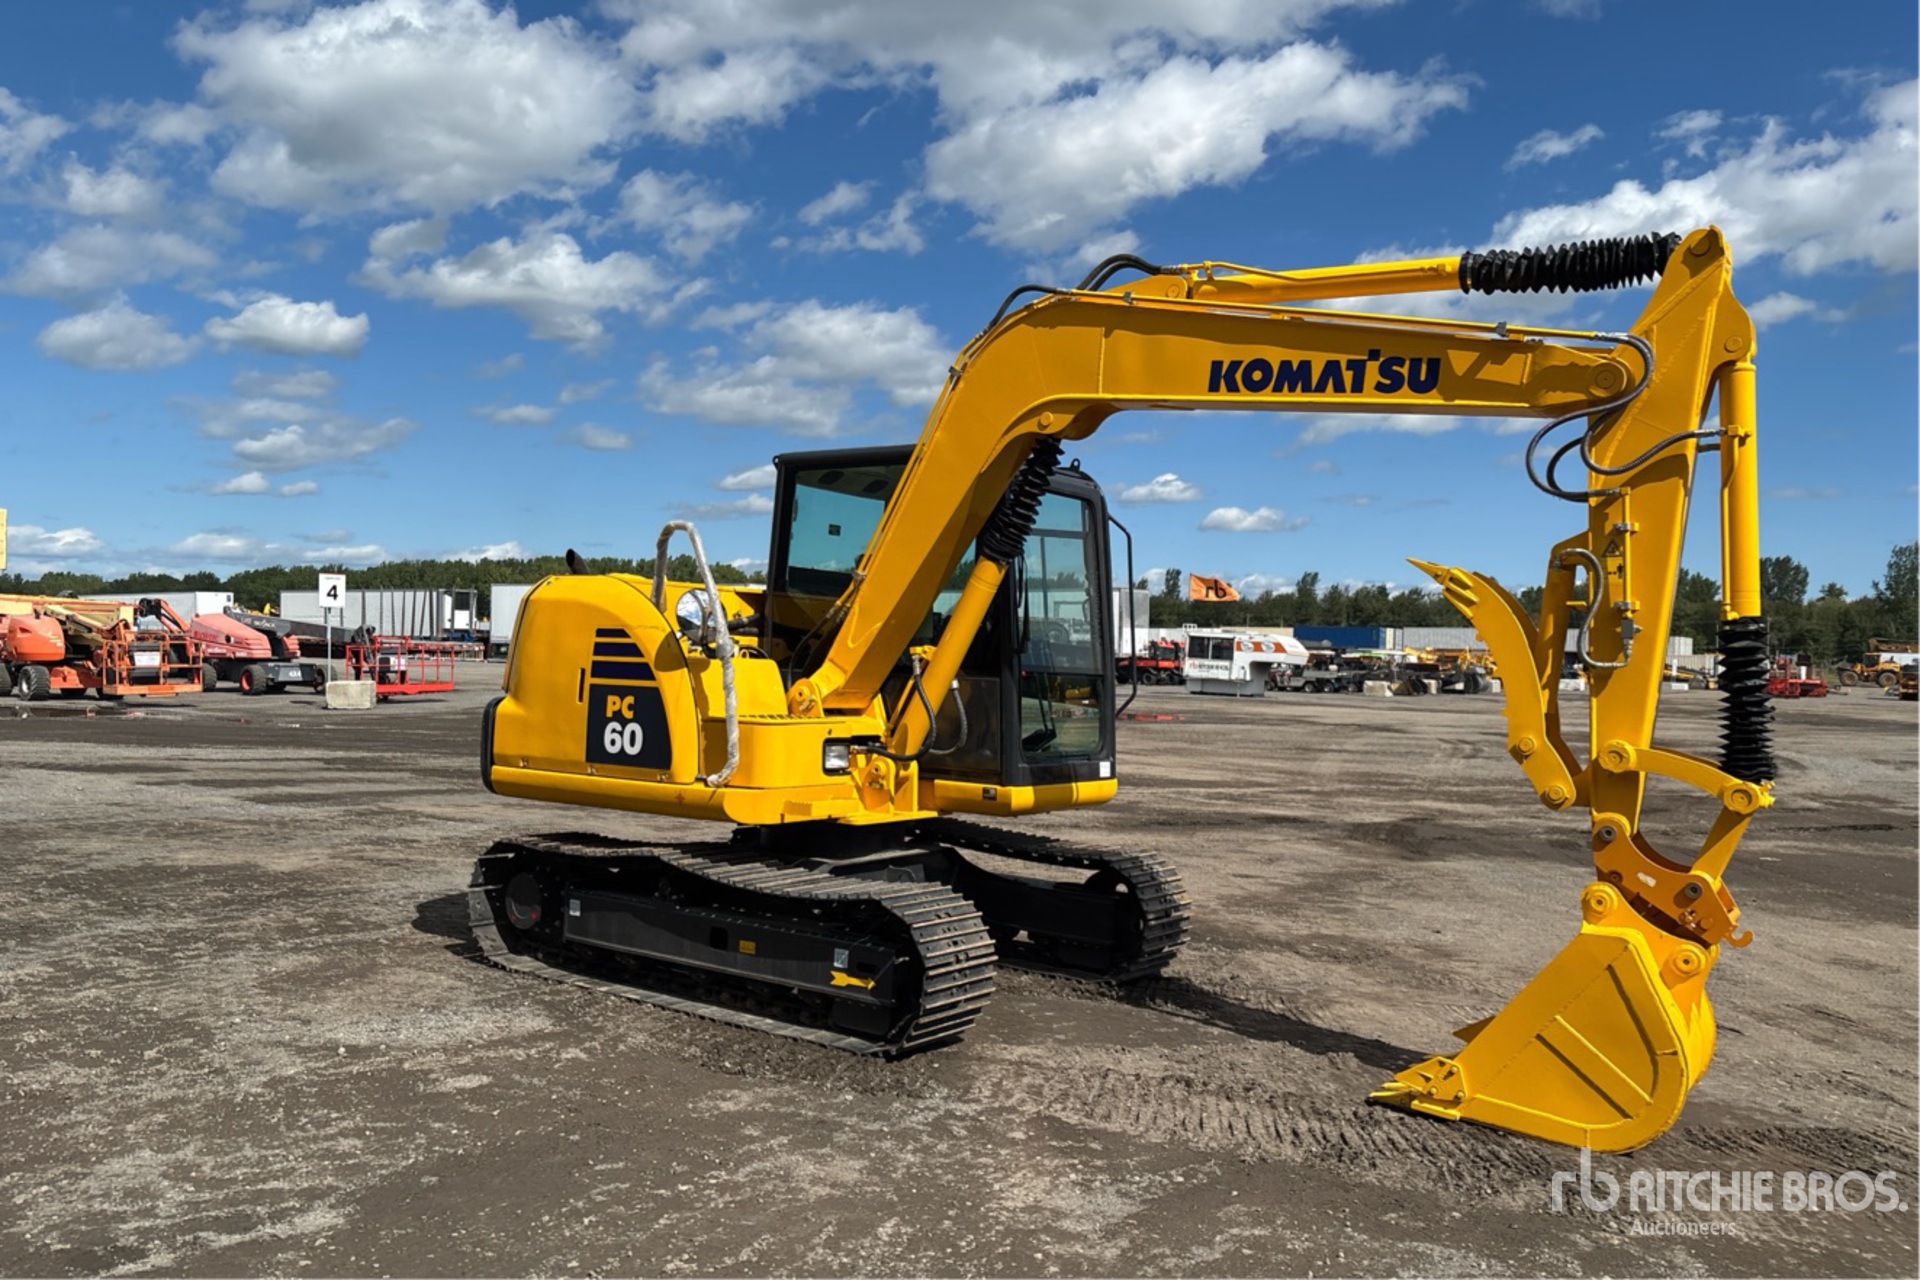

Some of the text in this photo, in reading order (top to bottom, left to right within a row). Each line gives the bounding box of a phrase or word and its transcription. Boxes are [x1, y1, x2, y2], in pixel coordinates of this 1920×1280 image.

[1208, 349, 1441, 394] KOMATSU
[326, 584, 338, 600] 4
[1205, 579, 1227, 599] rb
[606, 694, 635, 719] PC
[603, 721, 643, 756] 60
